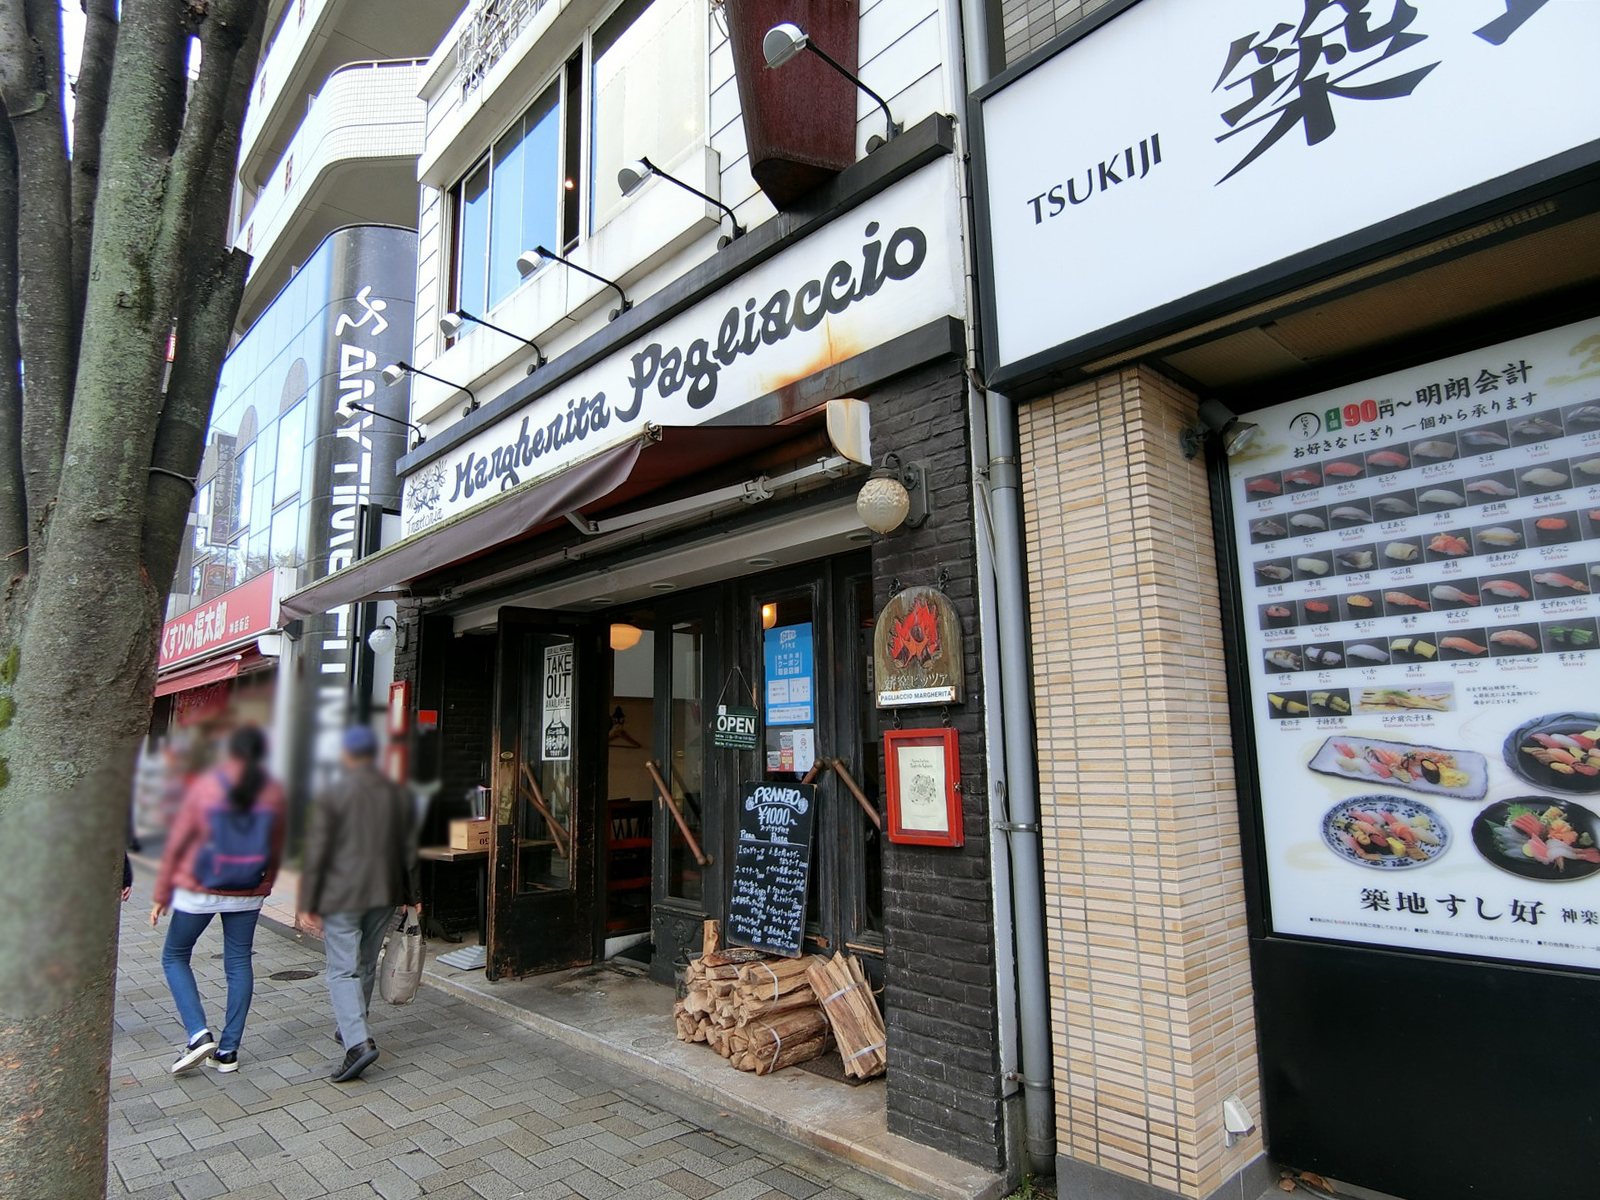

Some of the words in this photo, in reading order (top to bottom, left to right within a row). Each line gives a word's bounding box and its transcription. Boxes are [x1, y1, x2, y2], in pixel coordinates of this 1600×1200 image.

[1026, 132, 1163, 225] TSUKIJI
[448, 392, 612, 502] Margherita
[615, 221, 928, 424] Pagliaccio
[1416, 360, 1533, 408] 明朗会計
[161, 601, 228, 660] くすりの福太郎
[547, 654, 571, 674] TAKE
[546, 672, 571, 698] OUT
[880, 693, 913, 701] PAGLIACCIO
[914, 690, 951, 699] MARGHERITA
[717, 715, 755, 734] OPEN
[754, 786, 801, 806] PRANZO
[1360, 888, 1547, 926] 築地すし好
